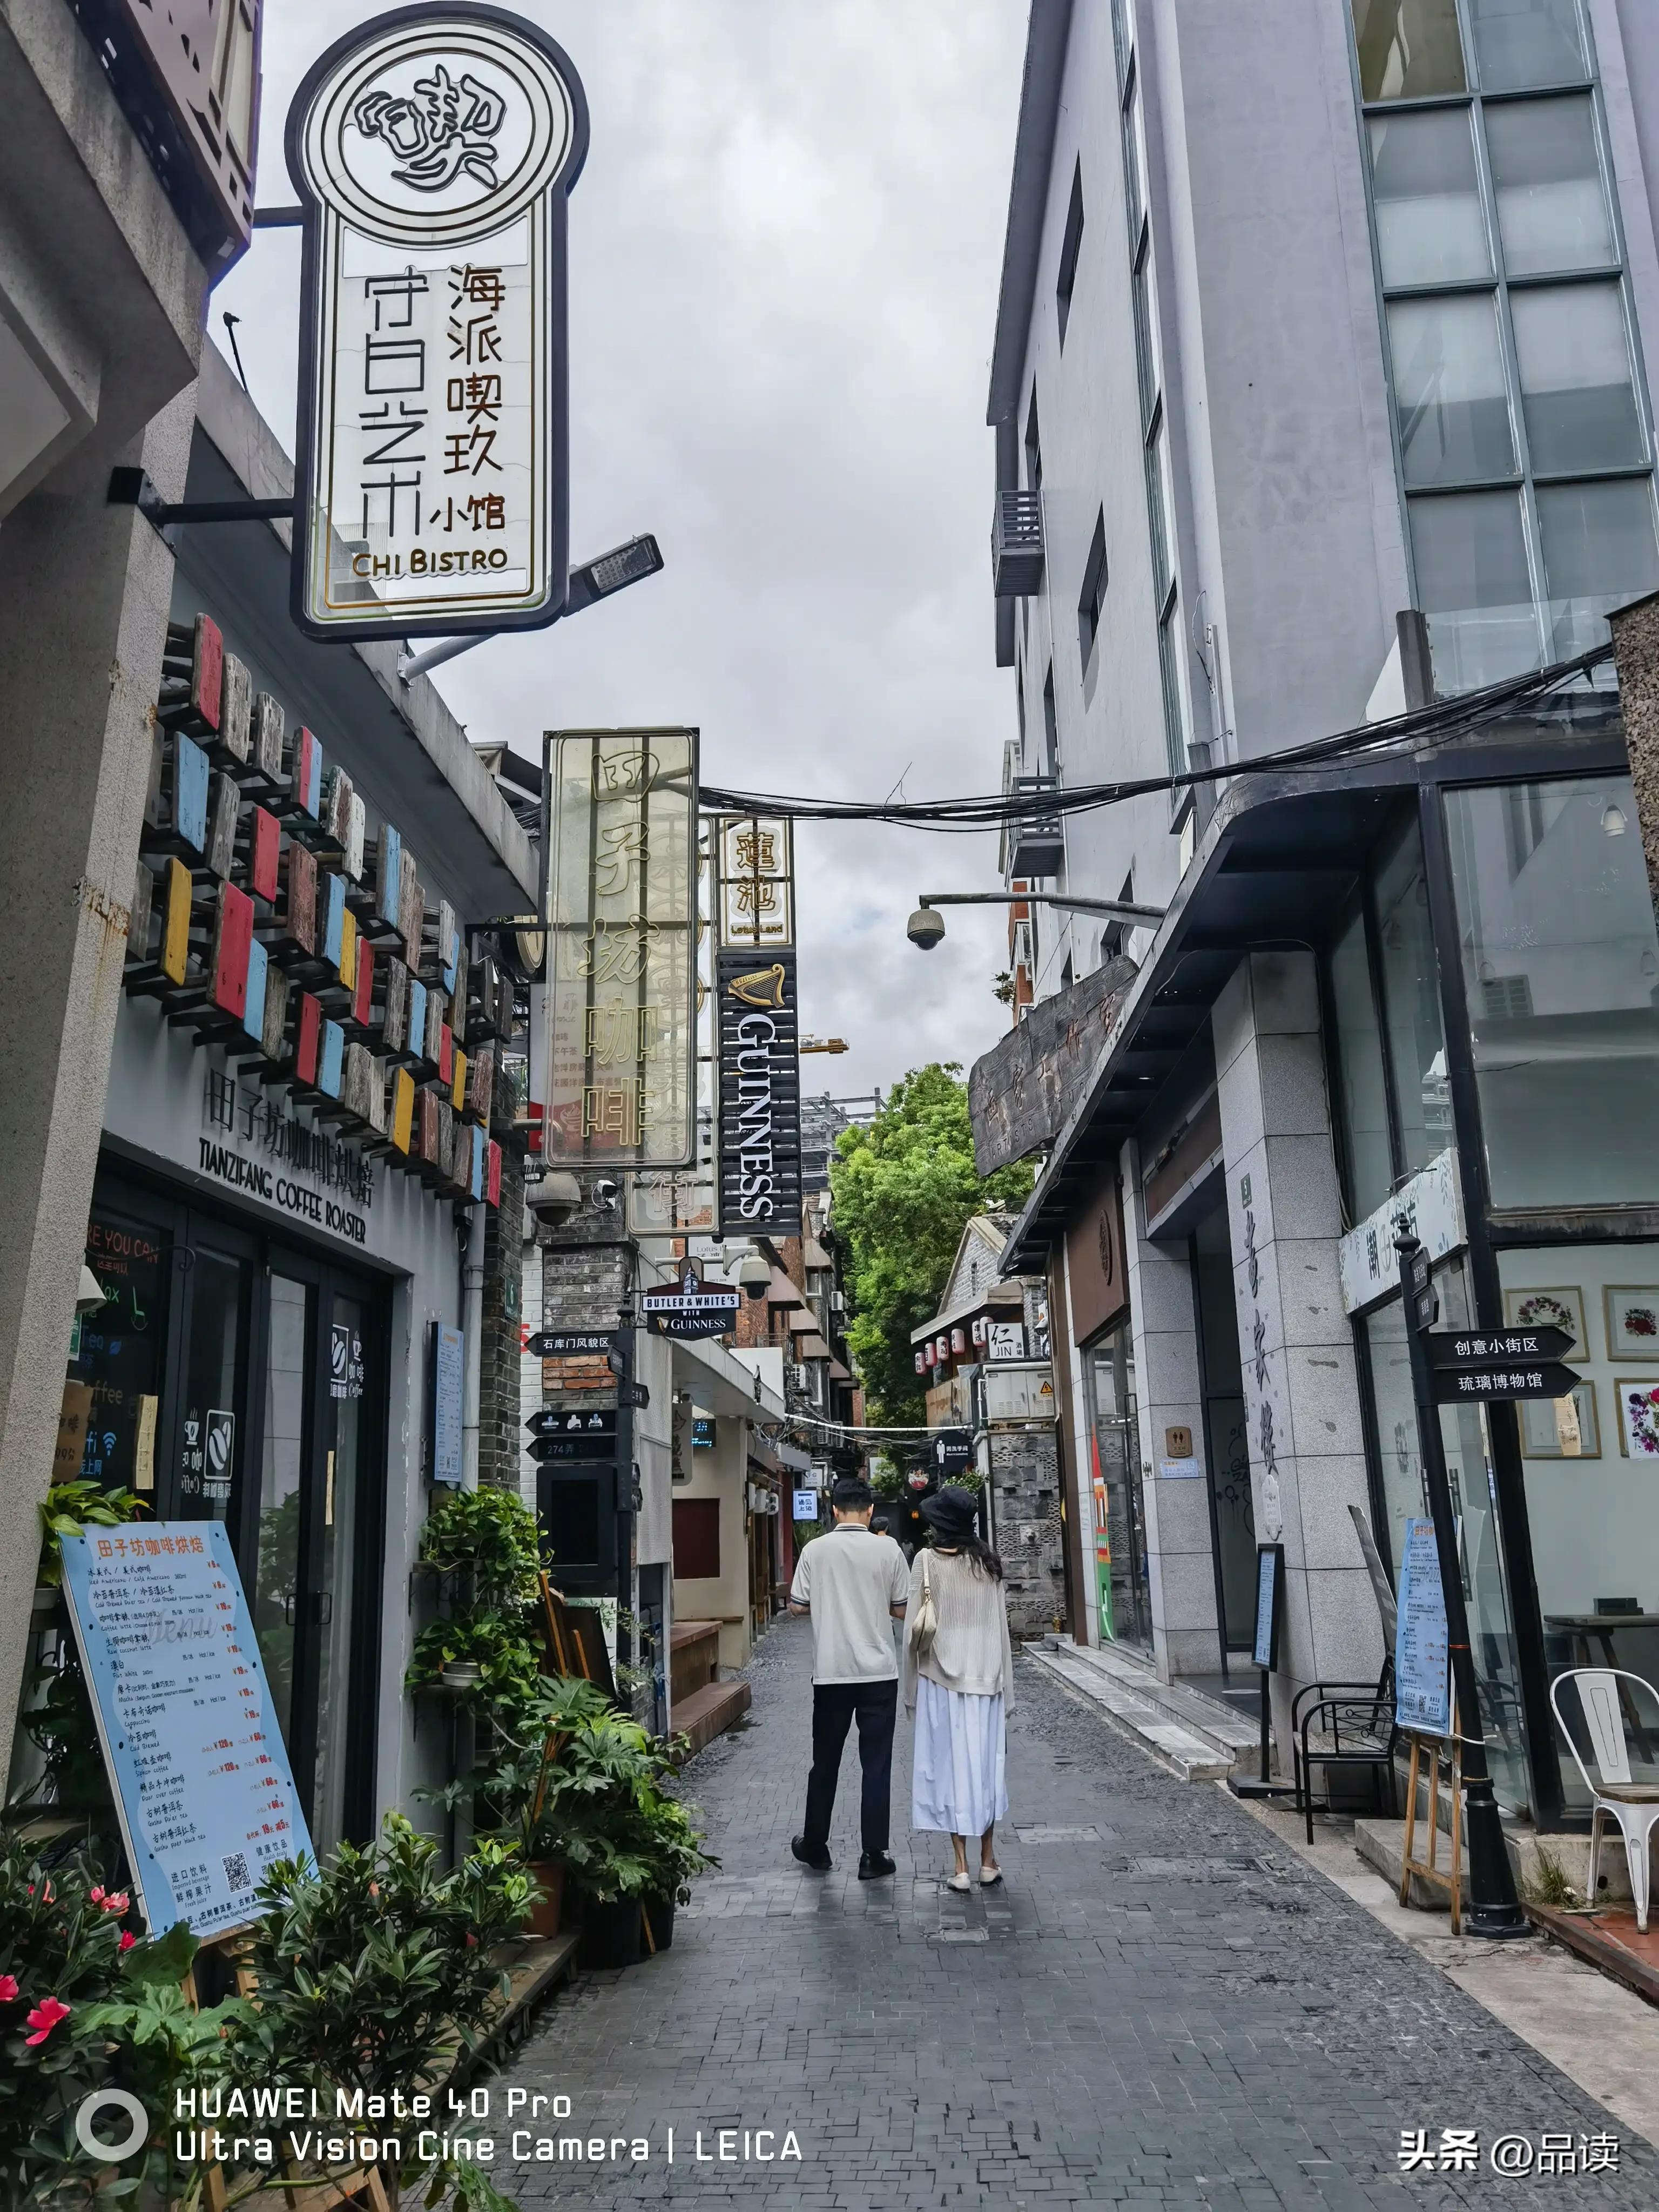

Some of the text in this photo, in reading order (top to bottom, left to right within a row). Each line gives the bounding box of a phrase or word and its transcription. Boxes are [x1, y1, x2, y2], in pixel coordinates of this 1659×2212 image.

[429, 494, 505, 531] 小馆
[352, 548, 509, 578] CHI BISTRO
[737, 832, 776, 911] 蓮池
[577, 750, 660, 1147] 田子坊咖啡
[738, 1013, 777, 1219] GUINNESS
[199, 1137, 366, 1244] TIANZIFANG COFFEE ROASTER
[105, 1229, 131, 1255] YOU
[648, 1298, 684, 1308] BUTLER
[695, 1296, 735, 1306] WHITE'S
[671, 1318, 726, 1330] GUINNESS
[543, 1337, 609, 1349] 石库门风貌区
[991, 1325, 1014, 1346] 仁
[996, 1346, 1011, 1357] JIN
[1454, 1337, 1539, 1355] 创意小街区
[1458, 1372, 1543, 1391] 琉璃博物馆
[98, 1535, 205, 1558] 田子坊咖啡烘焙
[256, 1839, 288, 1857] 健康饮品
[171, 1864, 208, 1883] 进口饮料
[176, 1885, 212, 1903] 鲜榨果汁
